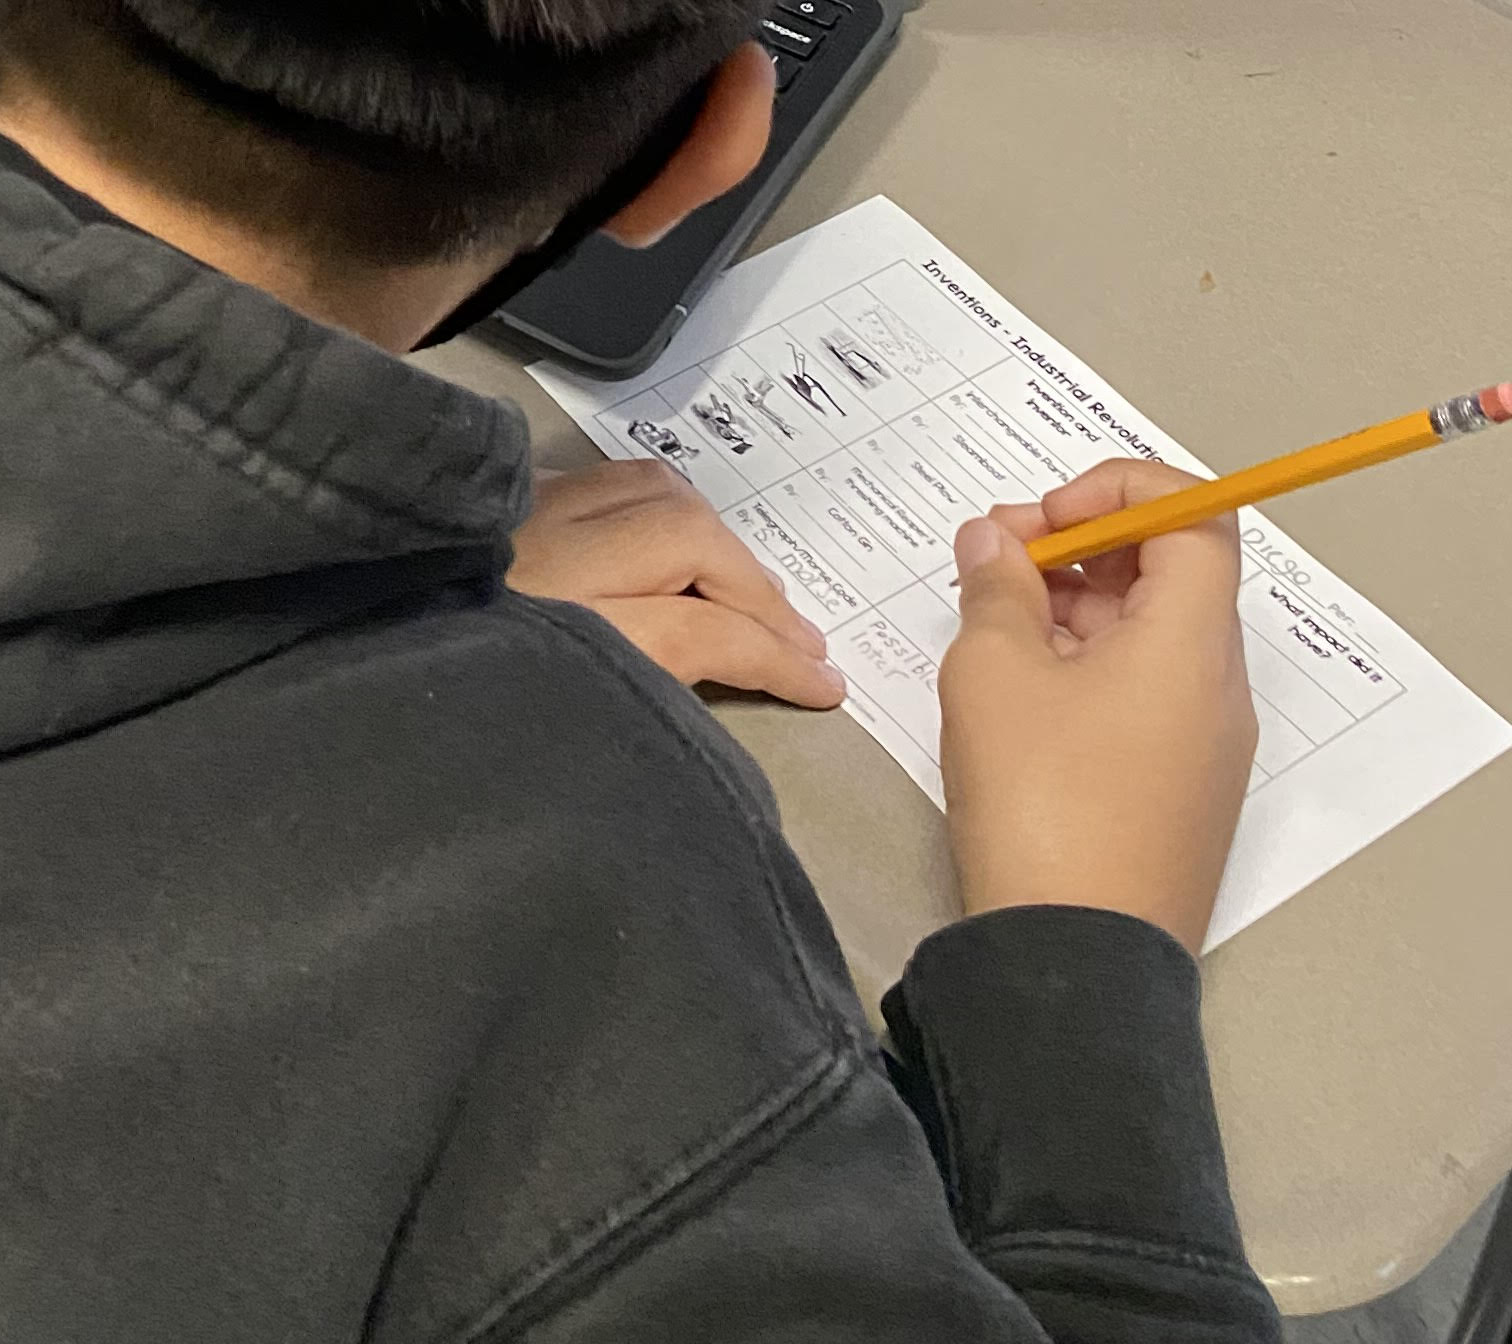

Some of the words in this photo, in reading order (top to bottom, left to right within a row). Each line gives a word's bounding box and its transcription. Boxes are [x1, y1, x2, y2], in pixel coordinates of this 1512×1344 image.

[922, 258, 1002, 329] Inventions
[1010, 335, 1094, 403] Industrial
[1088, 401, 1167, 465] Revolutio
[1075, 421, 1102, 443] and
[952, 433, 1007, 481] Steamboat
[851, 466, 898, 513] Mechanical
[911, 461, 936, 486] Steel
[934, 481, 959, 504] Plow
[827, 506, 858, 539] Cotton
[856, 535, 874, 553] Gin
[883, 511, 920, 549] machine
[832, 582, 858, 609] Code
[1269, 585, 1305, 617] What
[1301, 614, 1350, 654] impact
[1347, 653, 1373, 675] did
[1368, 672, 1383, 684] it
[1287, 624, 1332, 659] have?
